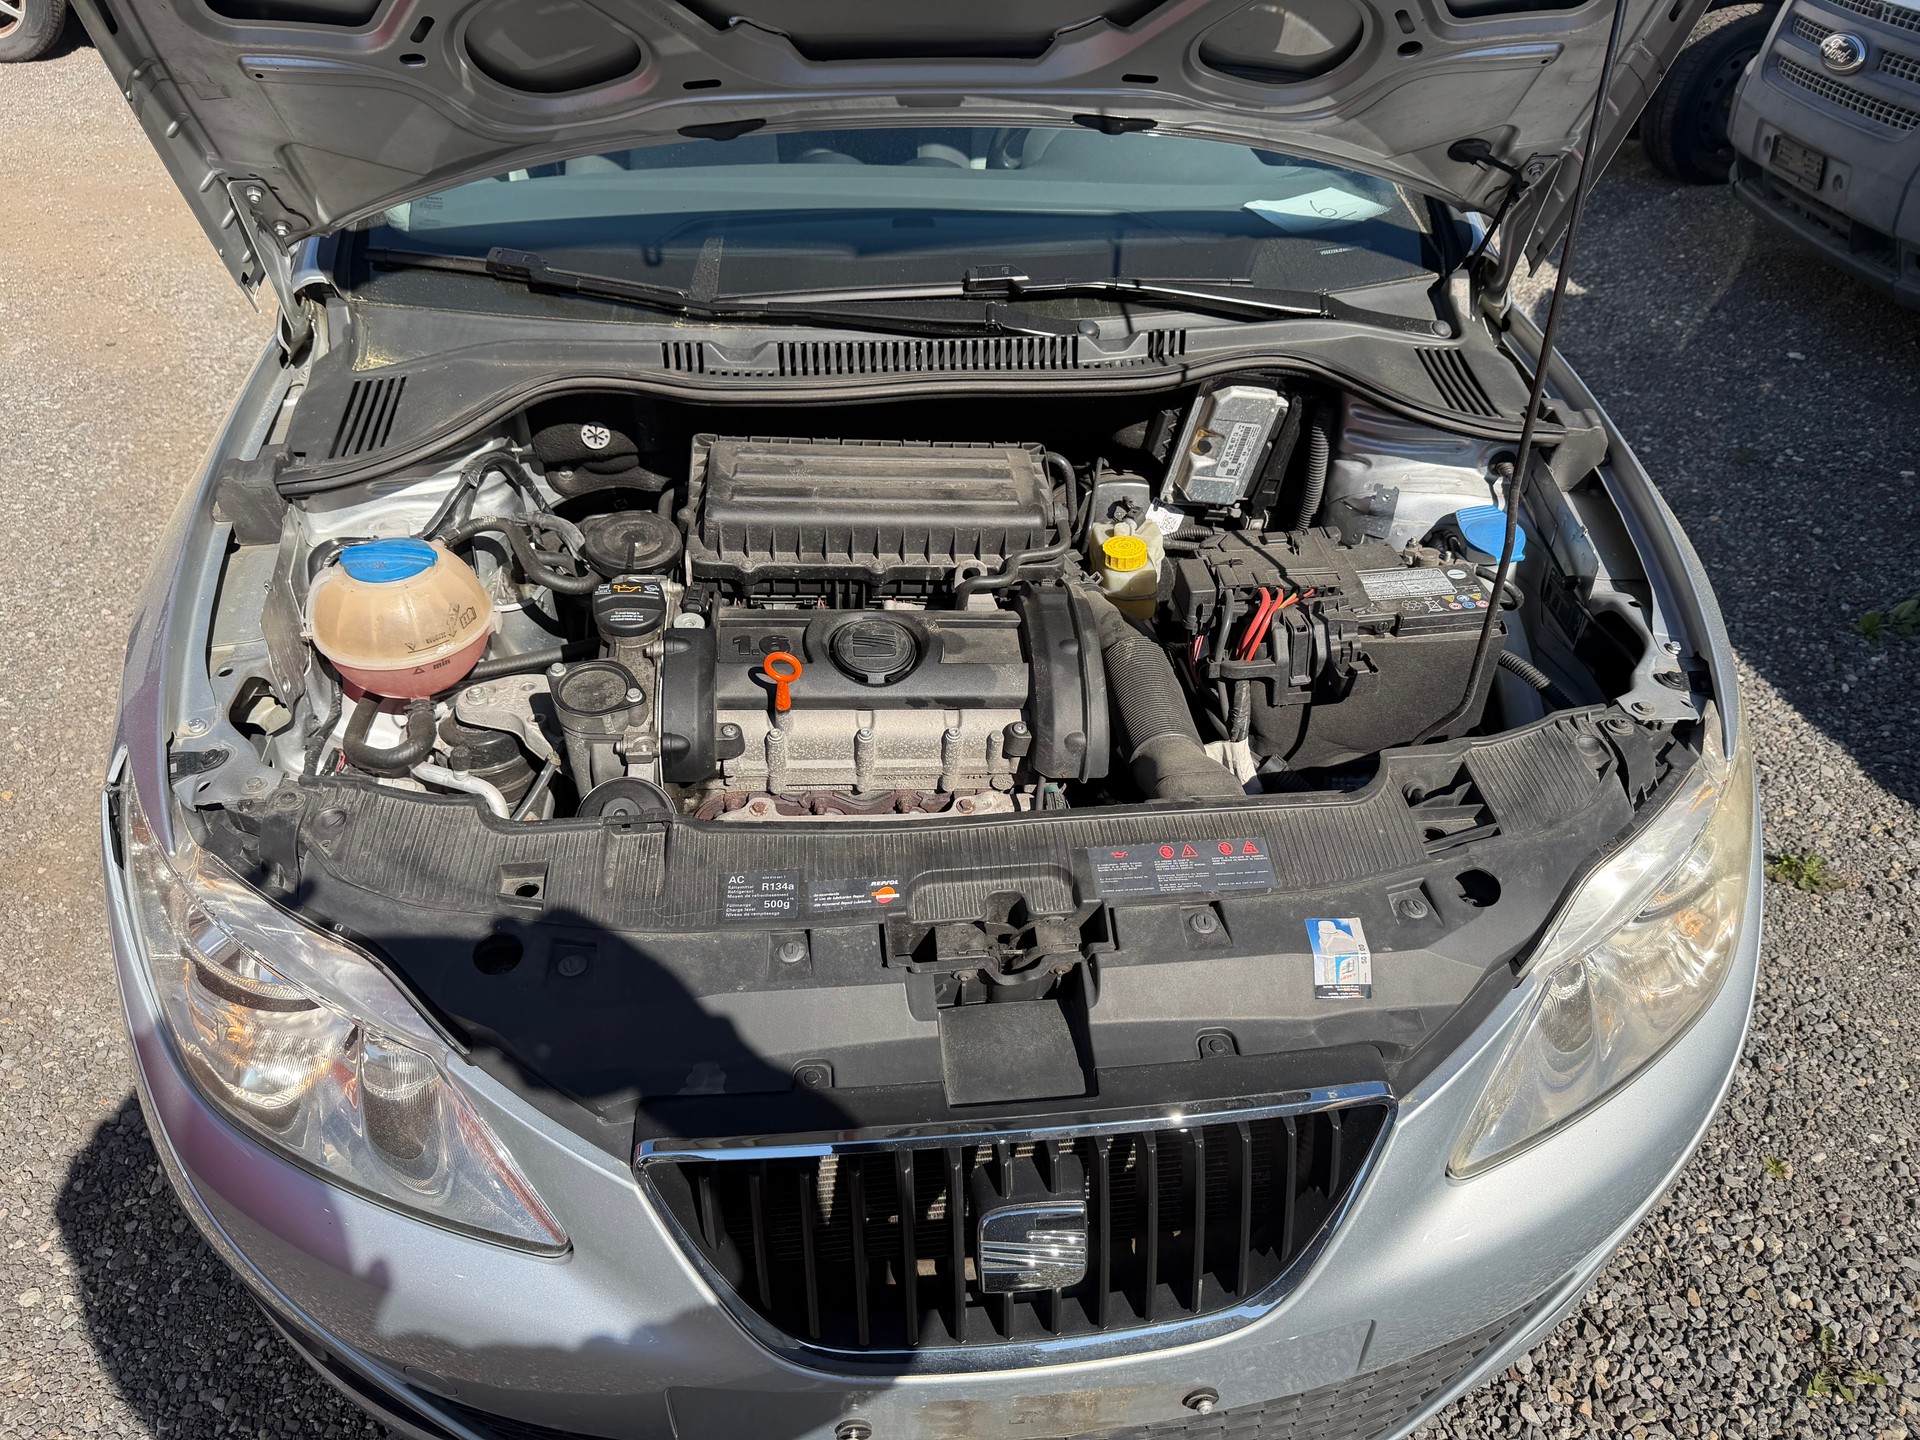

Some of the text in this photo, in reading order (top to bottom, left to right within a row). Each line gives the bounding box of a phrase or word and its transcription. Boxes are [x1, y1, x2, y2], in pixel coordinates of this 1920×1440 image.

[1824, 38, 1851, 63] Ford
[433, 659, 451, 670] min
[728, 876, 744, 884] AC
[762, 882, 794, 890] R134a
[764, 900, 790, 910] 500g
